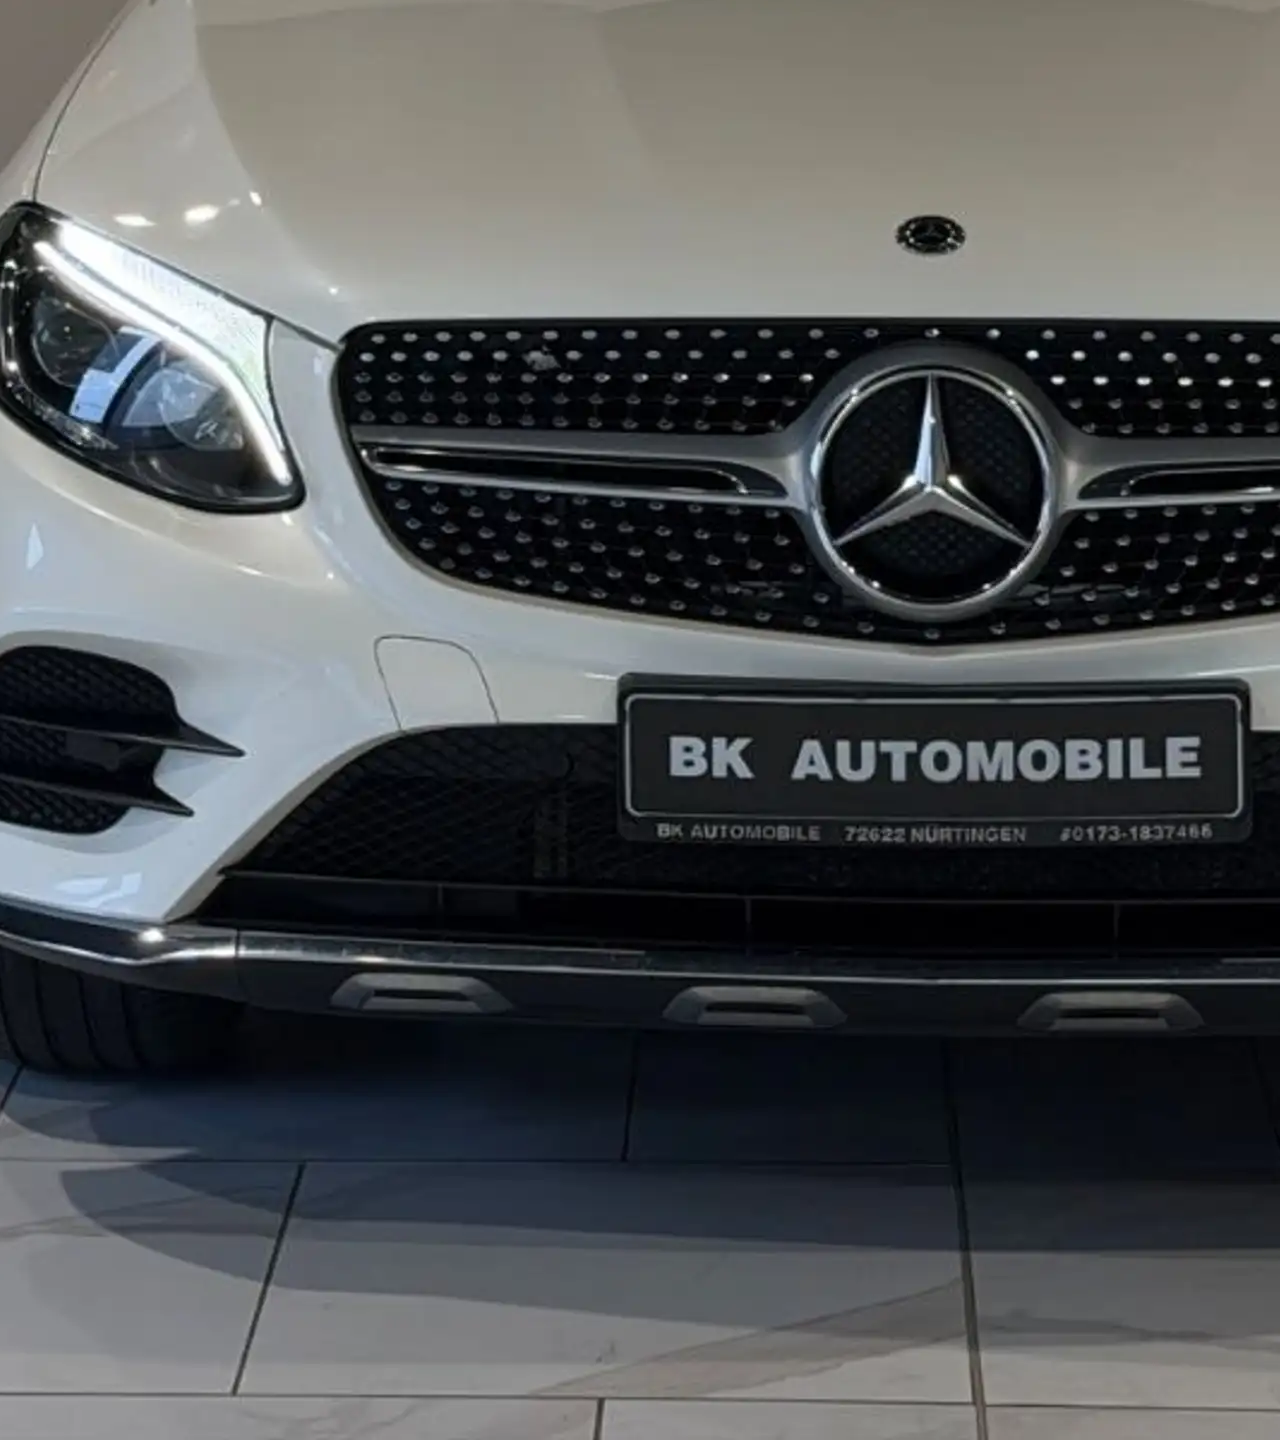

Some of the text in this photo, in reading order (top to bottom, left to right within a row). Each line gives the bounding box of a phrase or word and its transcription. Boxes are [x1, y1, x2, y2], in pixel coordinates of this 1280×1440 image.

[668, 736, 1202, 781] BK AUTOMOBILE
[656, 823, 683, 839] BK
[690, 824, 821, 841] AUTOMOBILE
